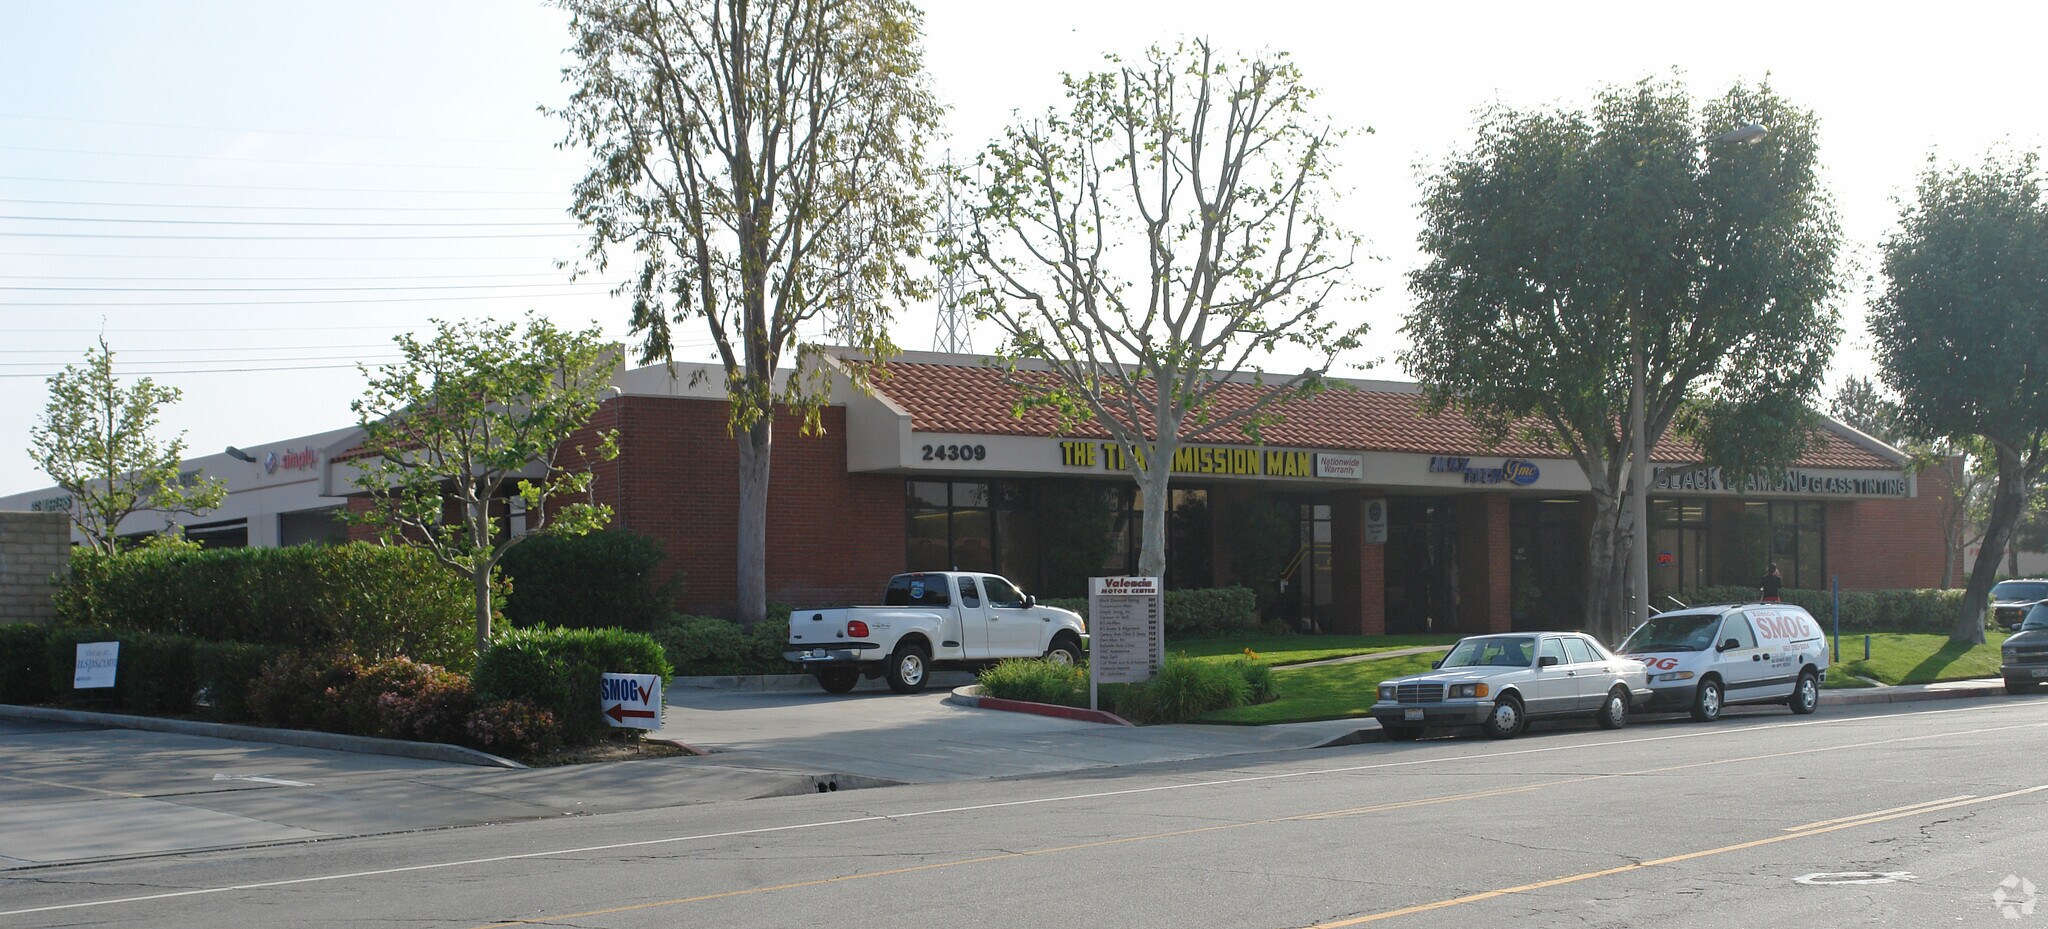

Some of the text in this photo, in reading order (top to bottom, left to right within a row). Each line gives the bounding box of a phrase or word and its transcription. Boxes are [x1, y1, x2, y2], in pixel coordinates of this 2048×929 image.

[922, 444, 987, 461] 24309
[1060, 441, 1096, 467] THE
[1264, 450, 1311, 477] MAN
[1320, 457, 1360, 467] Nationwide
[1323, 466, 1356, 476] Warranty
[1655, 466, 1722, 490] BLACK
[1811, 476, 1854, 494] GLASS
[1856, 477, 1907, 496] TINTING
[1105, 578, 1152, 587] Valencia
[1756, 616, 1811, 640] SMOG
[601, 678, 639, 702] SMOG
